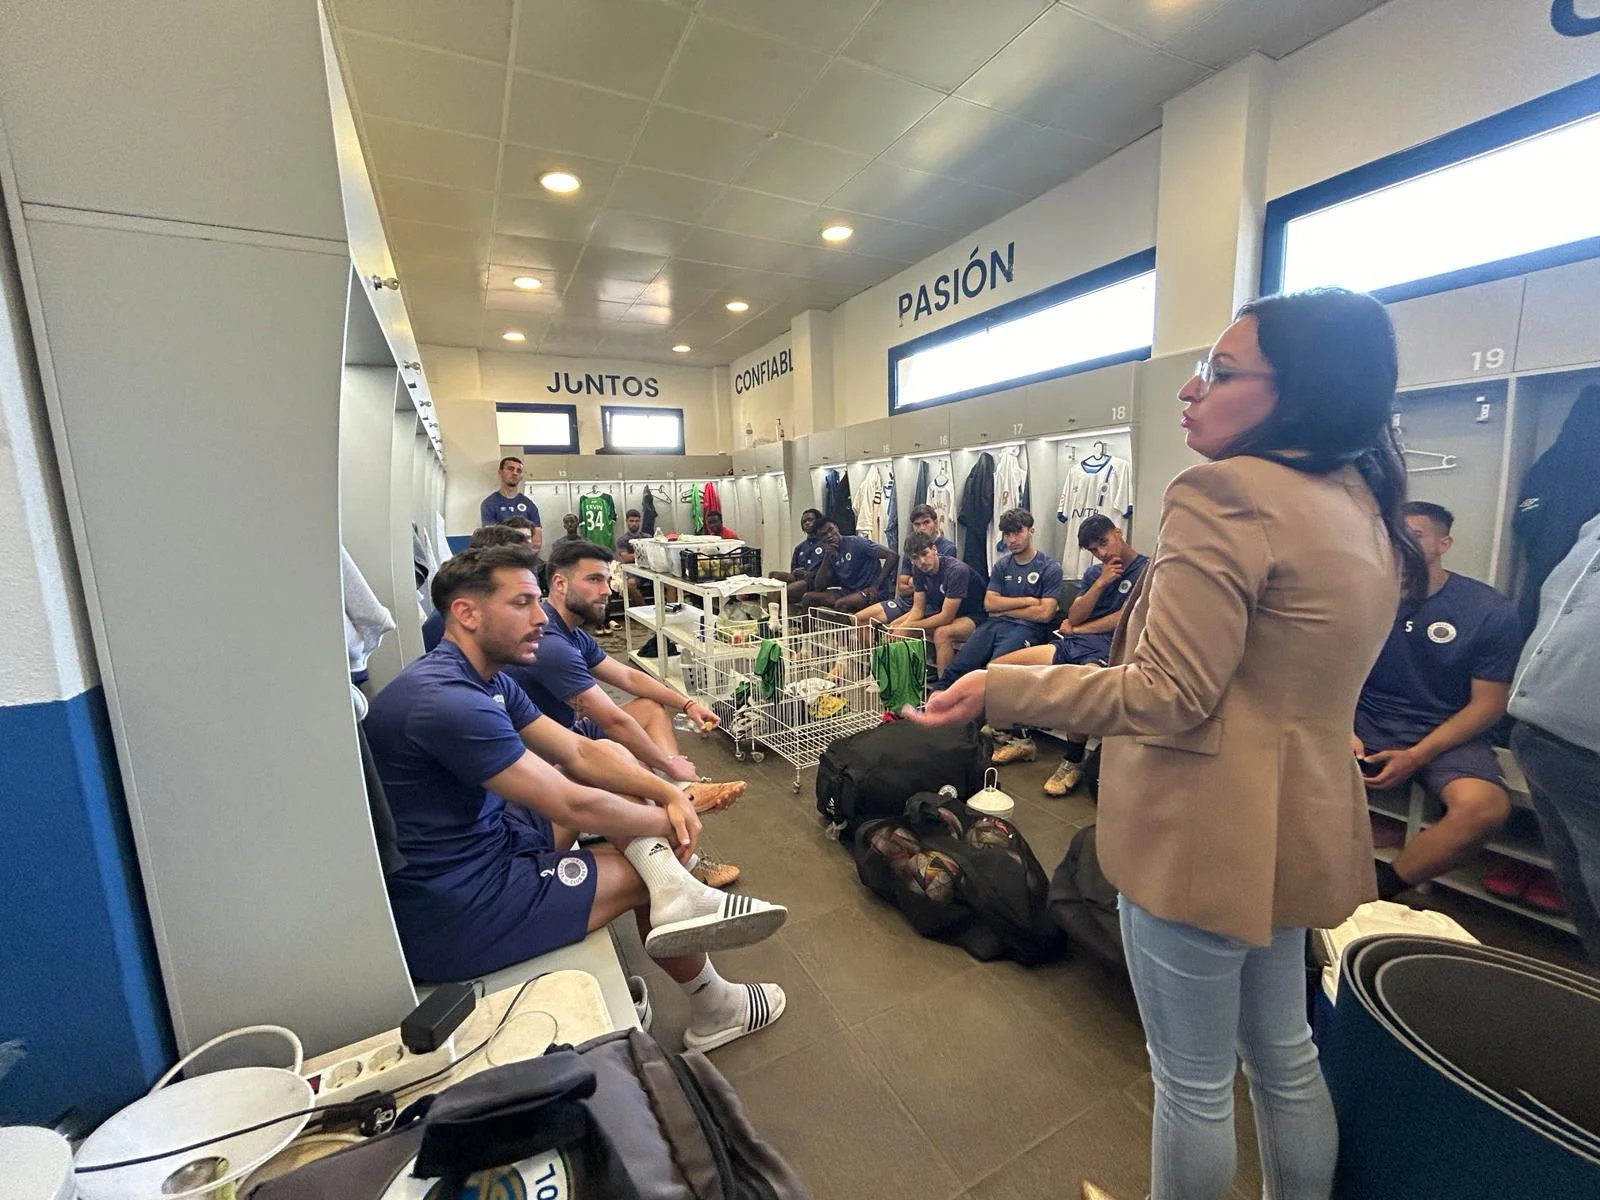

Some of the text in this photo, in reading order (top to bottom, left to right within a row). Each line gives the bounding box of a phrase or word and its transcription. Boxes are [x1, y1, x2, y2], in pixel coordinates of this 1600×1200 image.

[898, 241, 1015, 328] PASIÓN
[1471, 347, 1505, 372] 19
[547, 371, 659, 398] JUNTOS
[1111, 406, 1126, 422] 18
[1012, 423, 1024, 436] 17
[939, 434, 948, 447] 16
[585, 510, 605, 531] 34
[1405, 620, 1414, 633] 5
